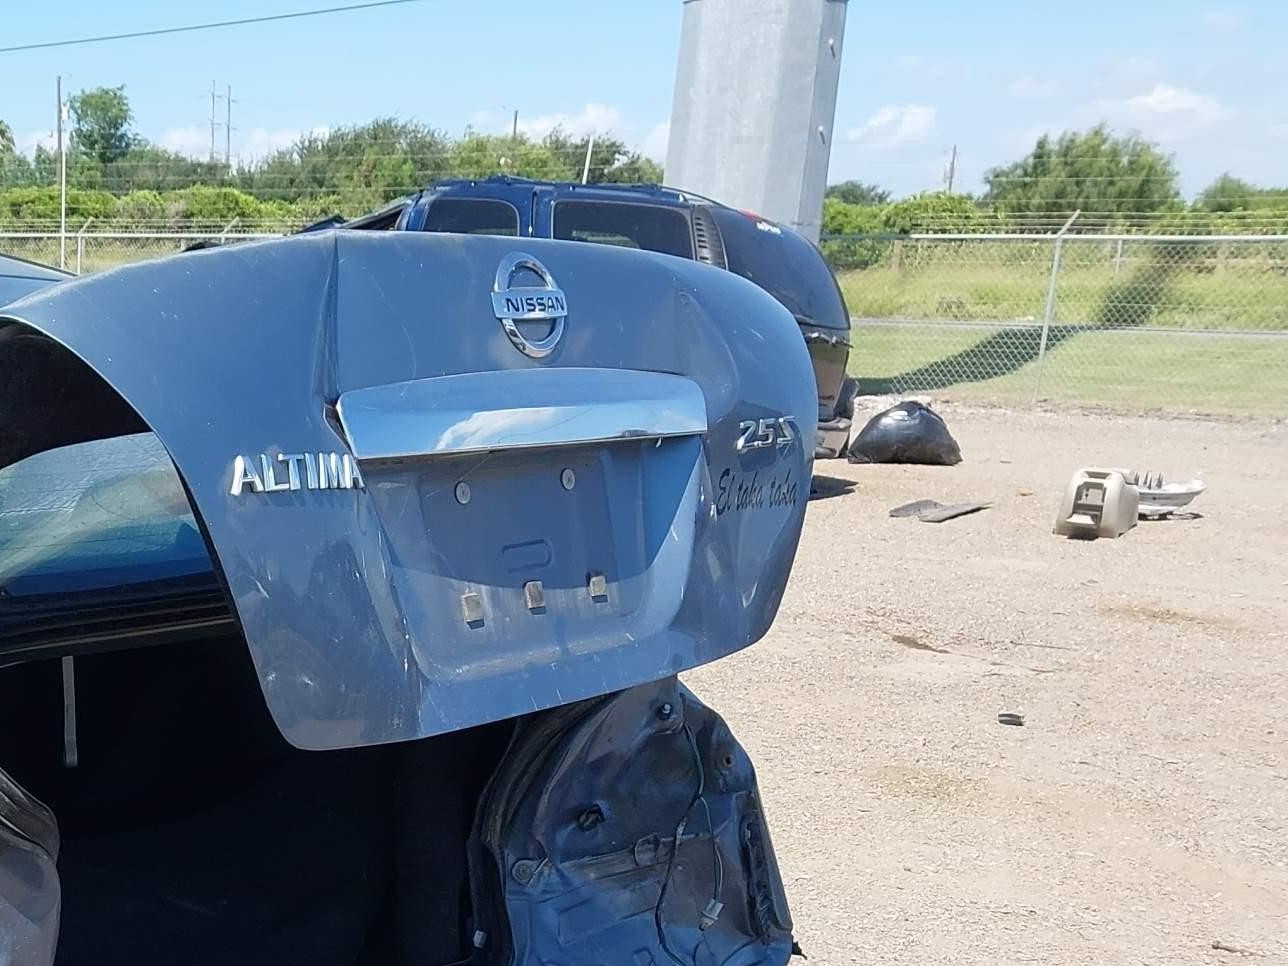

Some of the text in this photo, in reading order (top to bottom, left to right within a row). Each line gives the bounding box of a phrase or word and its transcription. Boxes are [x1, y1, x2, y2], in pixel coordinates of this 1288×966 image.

[504, 296, 565, 313] NISSAN
[230, 452, 365, 496] ALTIMA
[716, 467, 735, 516] El
